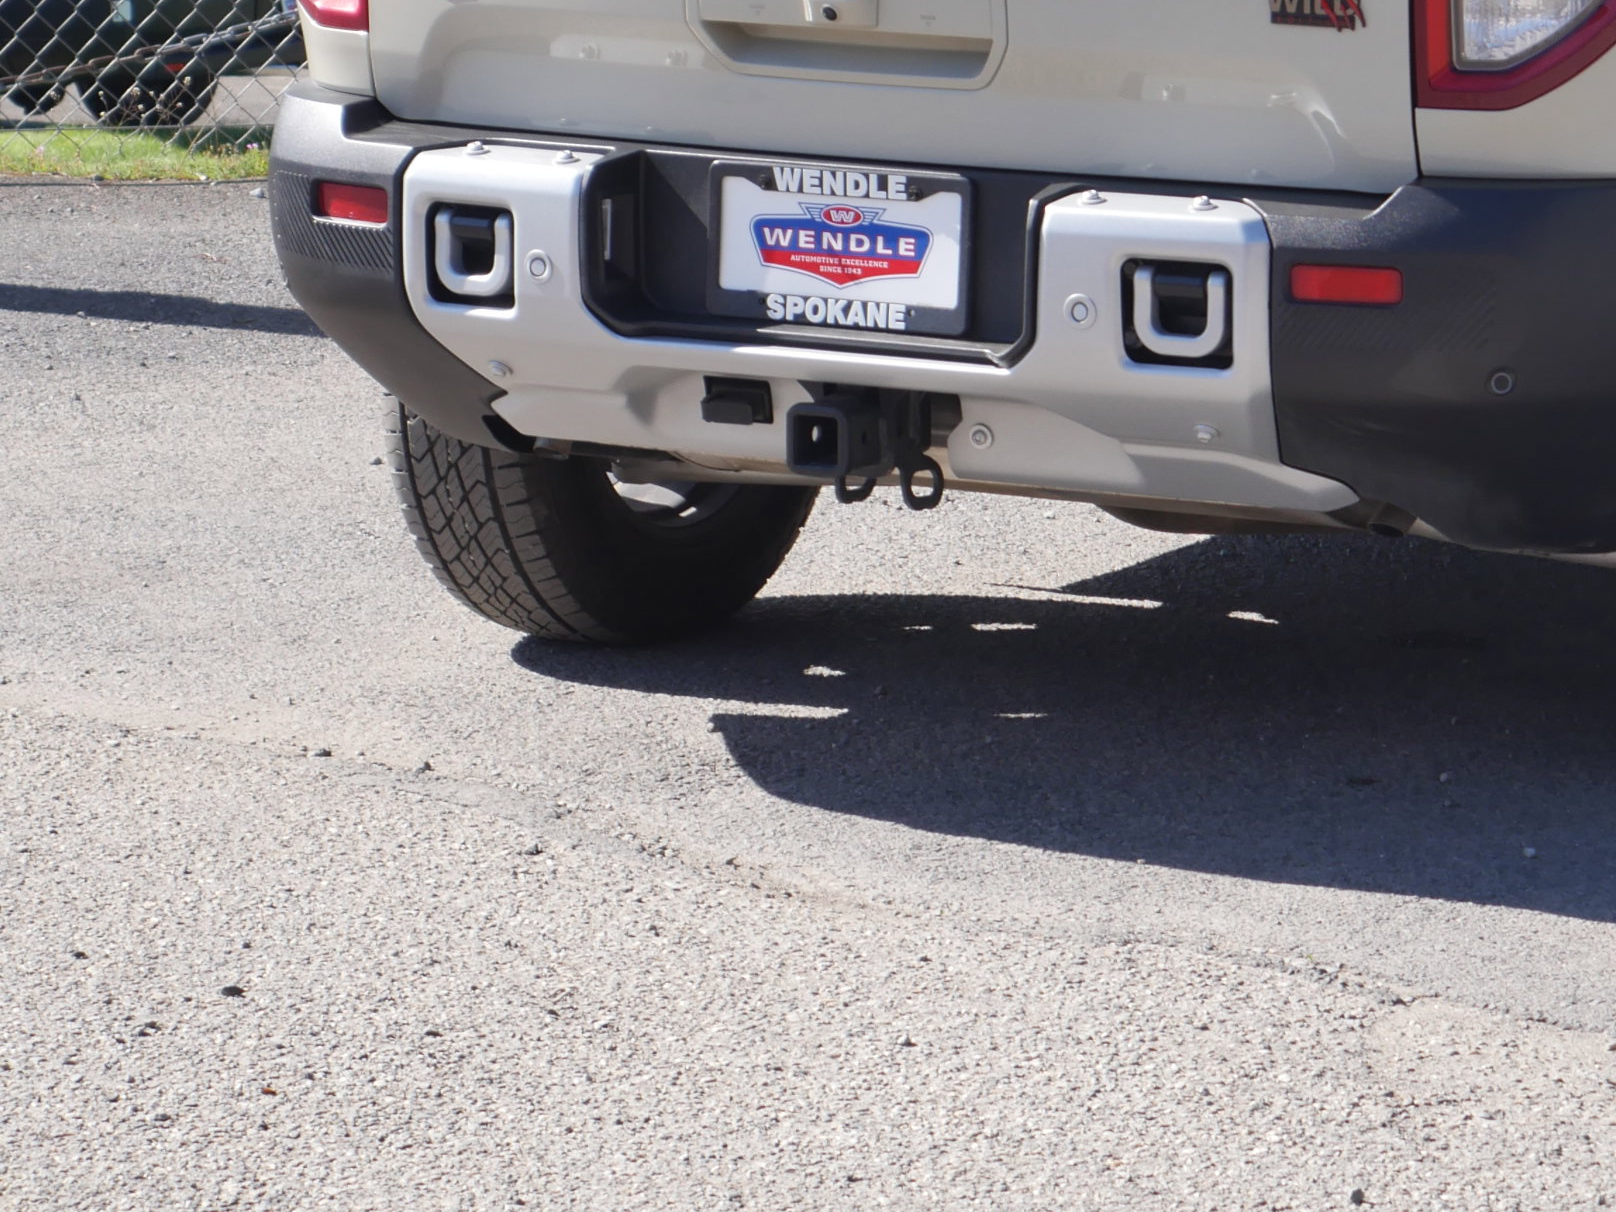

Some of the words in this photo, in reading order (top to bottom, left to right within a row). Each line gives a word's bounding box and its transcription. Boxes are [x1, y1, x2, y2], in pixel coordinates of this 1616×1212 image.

[773, 167, 907, 200] WENDLE
[763, 227, 915, 255] WENDLE
[790, 254, 839, 264] AUTOMOTIVE
[841, 258, 888, 268] EXCELLENCE
[819, 265, 842, 274] SINCE
[766, 293, 906, 330] SPOKANE
